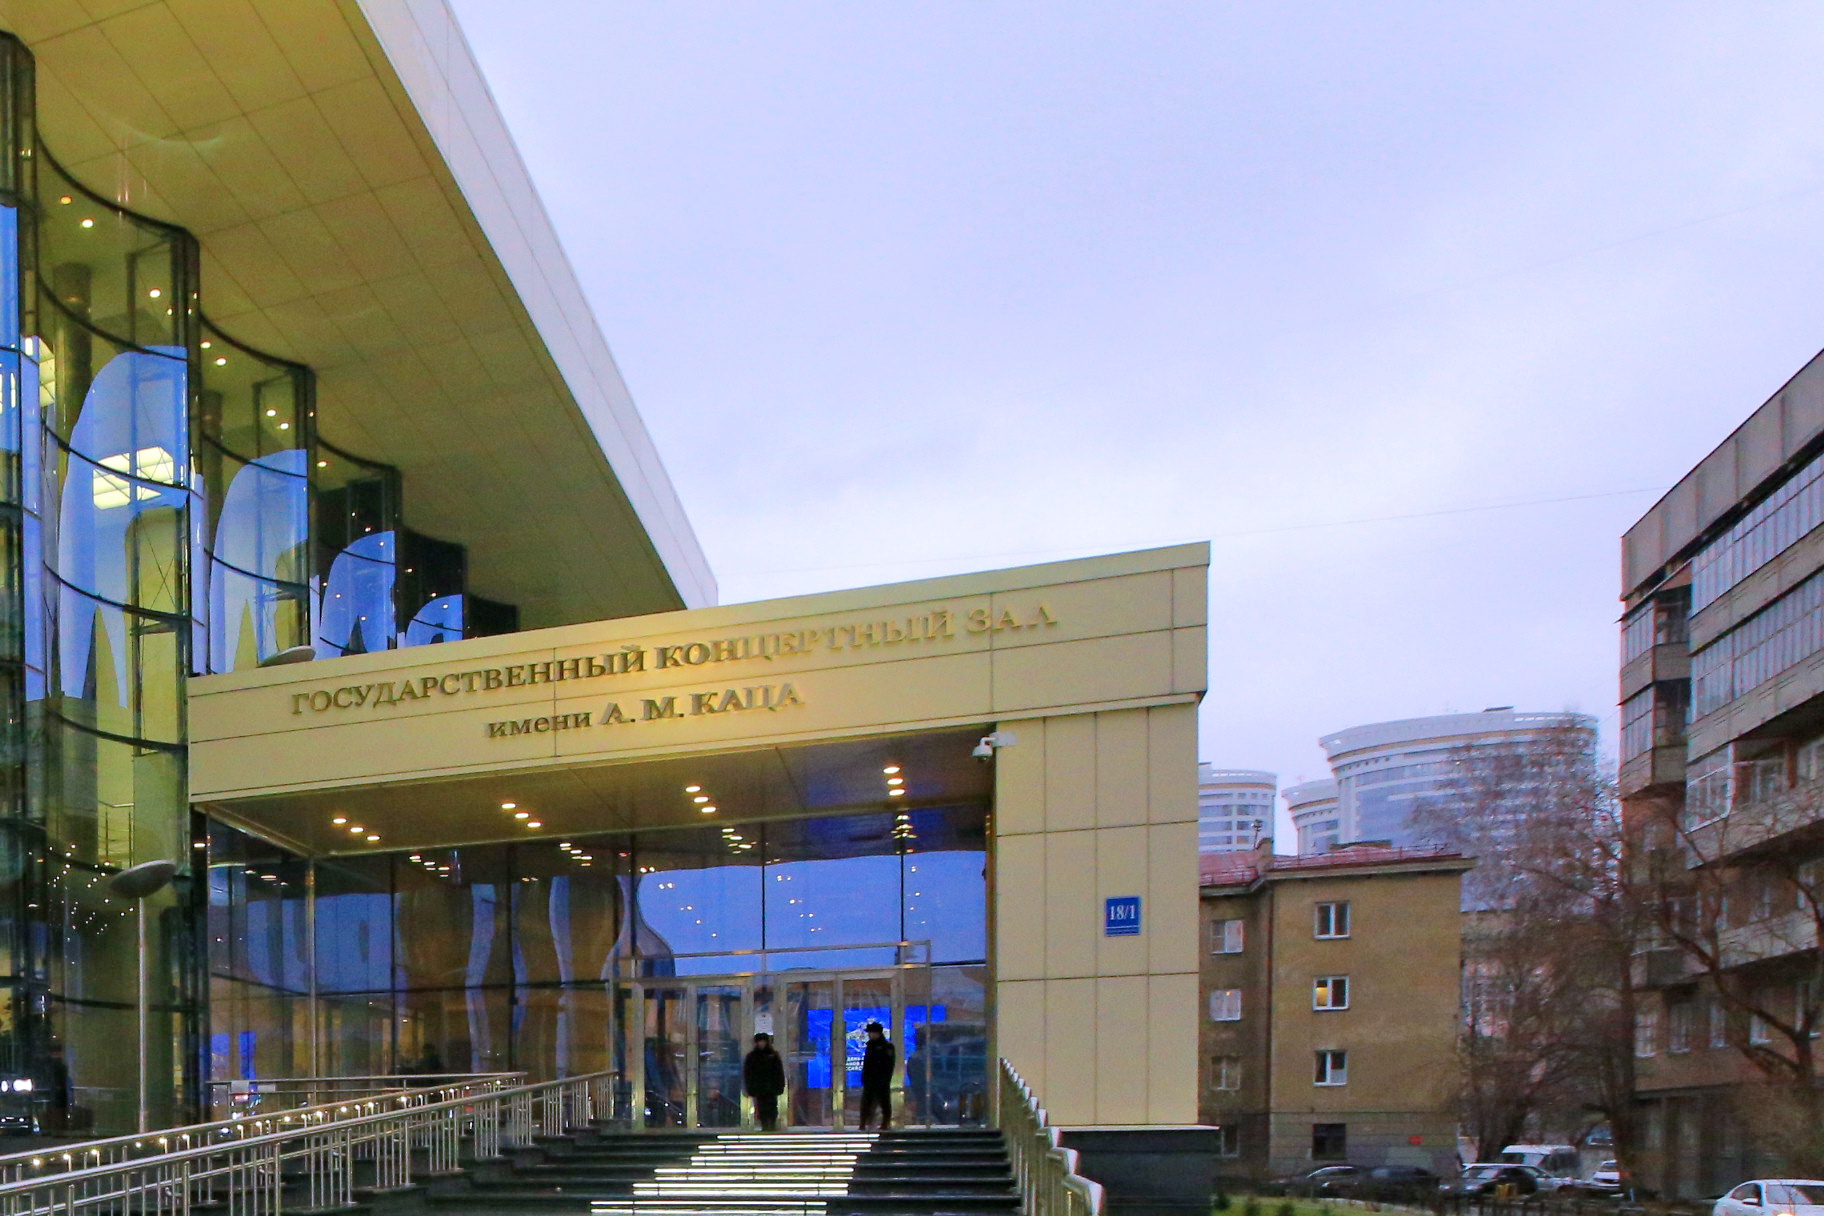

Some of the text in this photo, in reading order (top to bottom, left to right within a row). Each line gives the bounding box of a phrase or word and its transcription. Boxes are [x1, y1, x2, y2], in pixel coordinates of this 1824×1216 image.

[291, 599, 1057, 715] ГОСУДАРСТВЕННЫЙ КОНЦЕРТНЫЙ ЗАЛ
[488, 711, 592, 739] имени
[688, 682, 805, 716] КАЦА
[1110, 904, 1136, 920] 18/1
